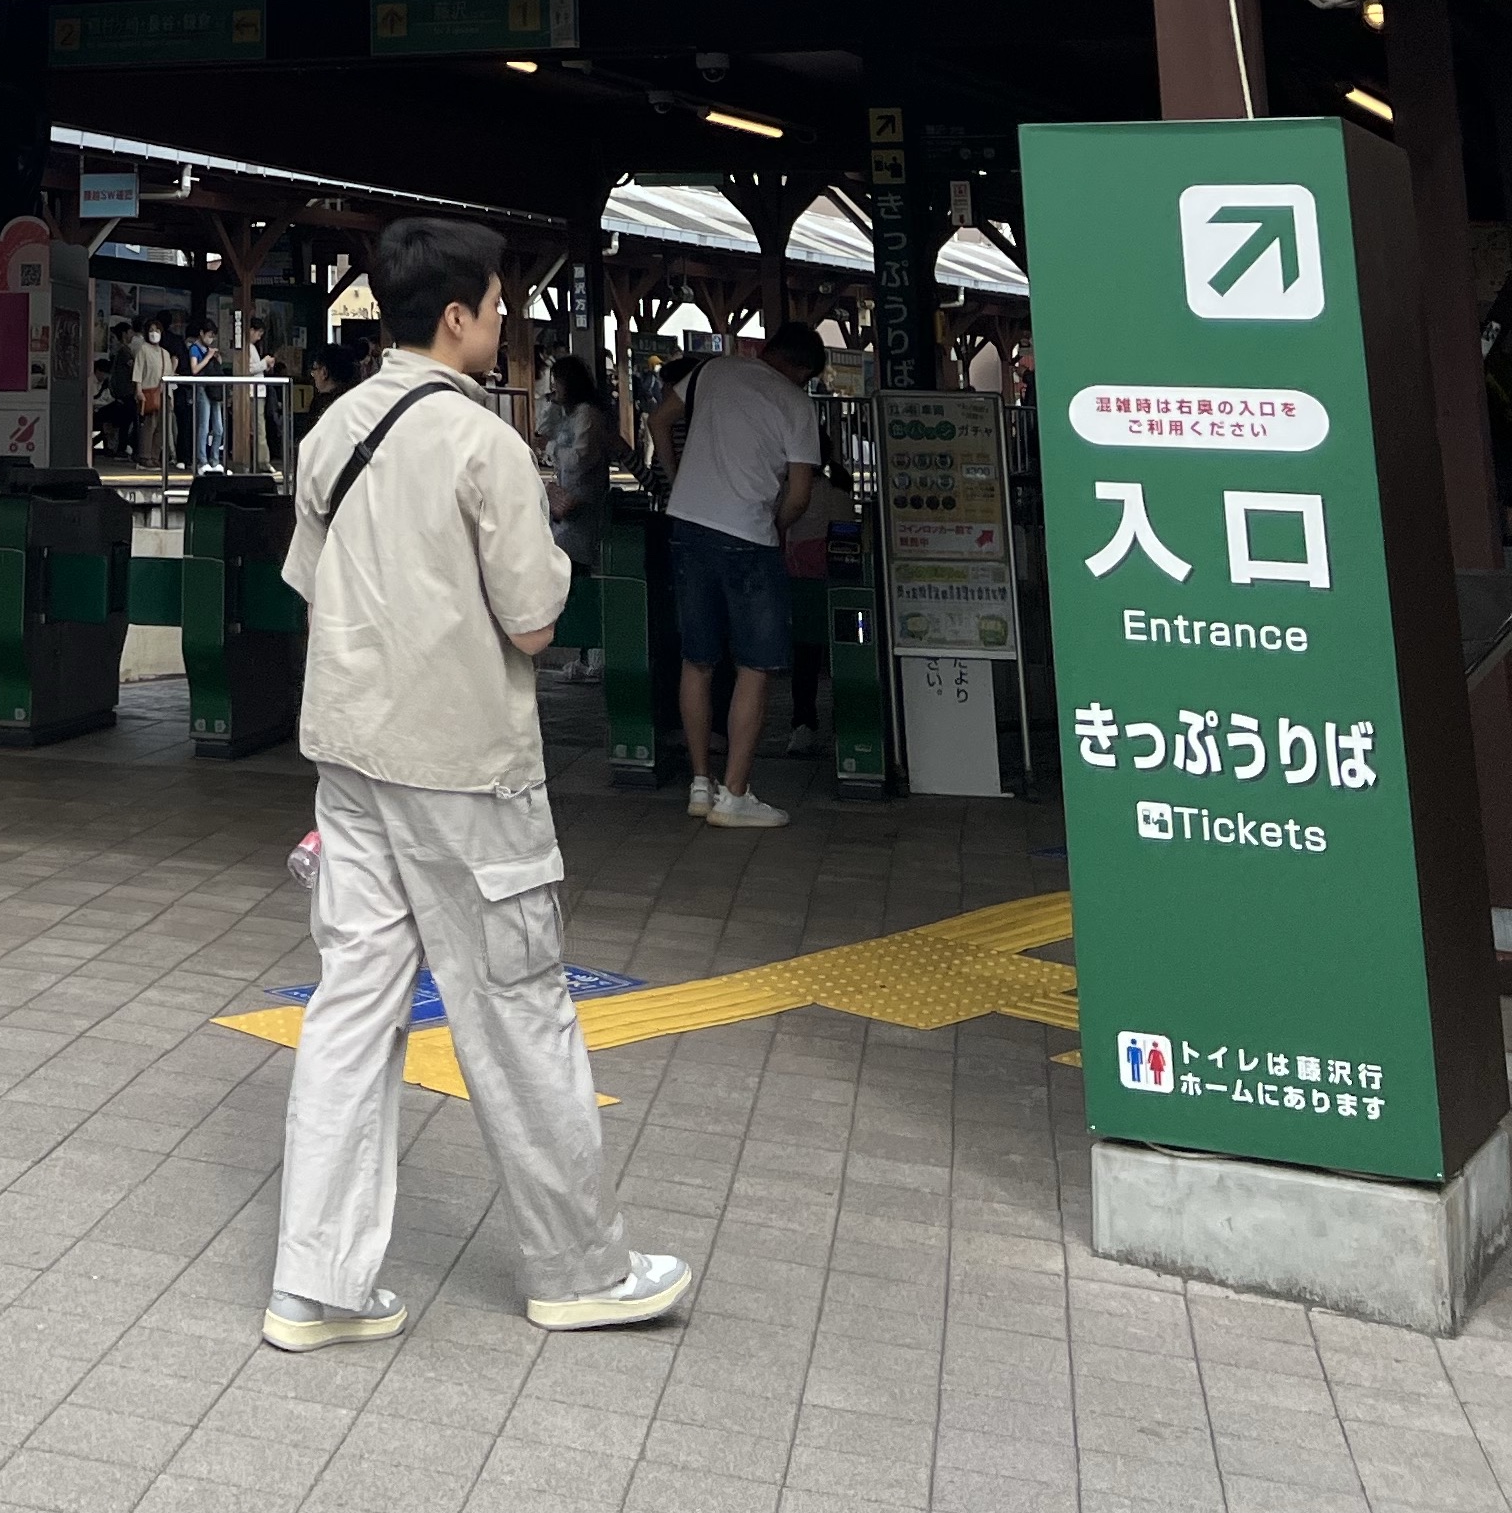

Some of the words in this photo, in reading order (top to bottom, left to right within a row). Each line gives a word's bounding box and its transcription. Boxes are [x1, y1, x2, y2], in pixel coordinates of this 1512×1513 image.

[1095, 396, 1298, 419] 混雑時は右奥の入口を
[1128, 418, 1268, 439] ご利用ください
[1084, 480, 1331, 589] 入口
[1122, 609, 1310, 653] Entrance
[1074, 701, 1378, 789] きっぷうりば
[1173, 805, 1328, 853] Tickets
[1182, 1040, 1384, 1090] トイレは藤沢行
[1180, 1072, 1386, 1122] ホームにあります
